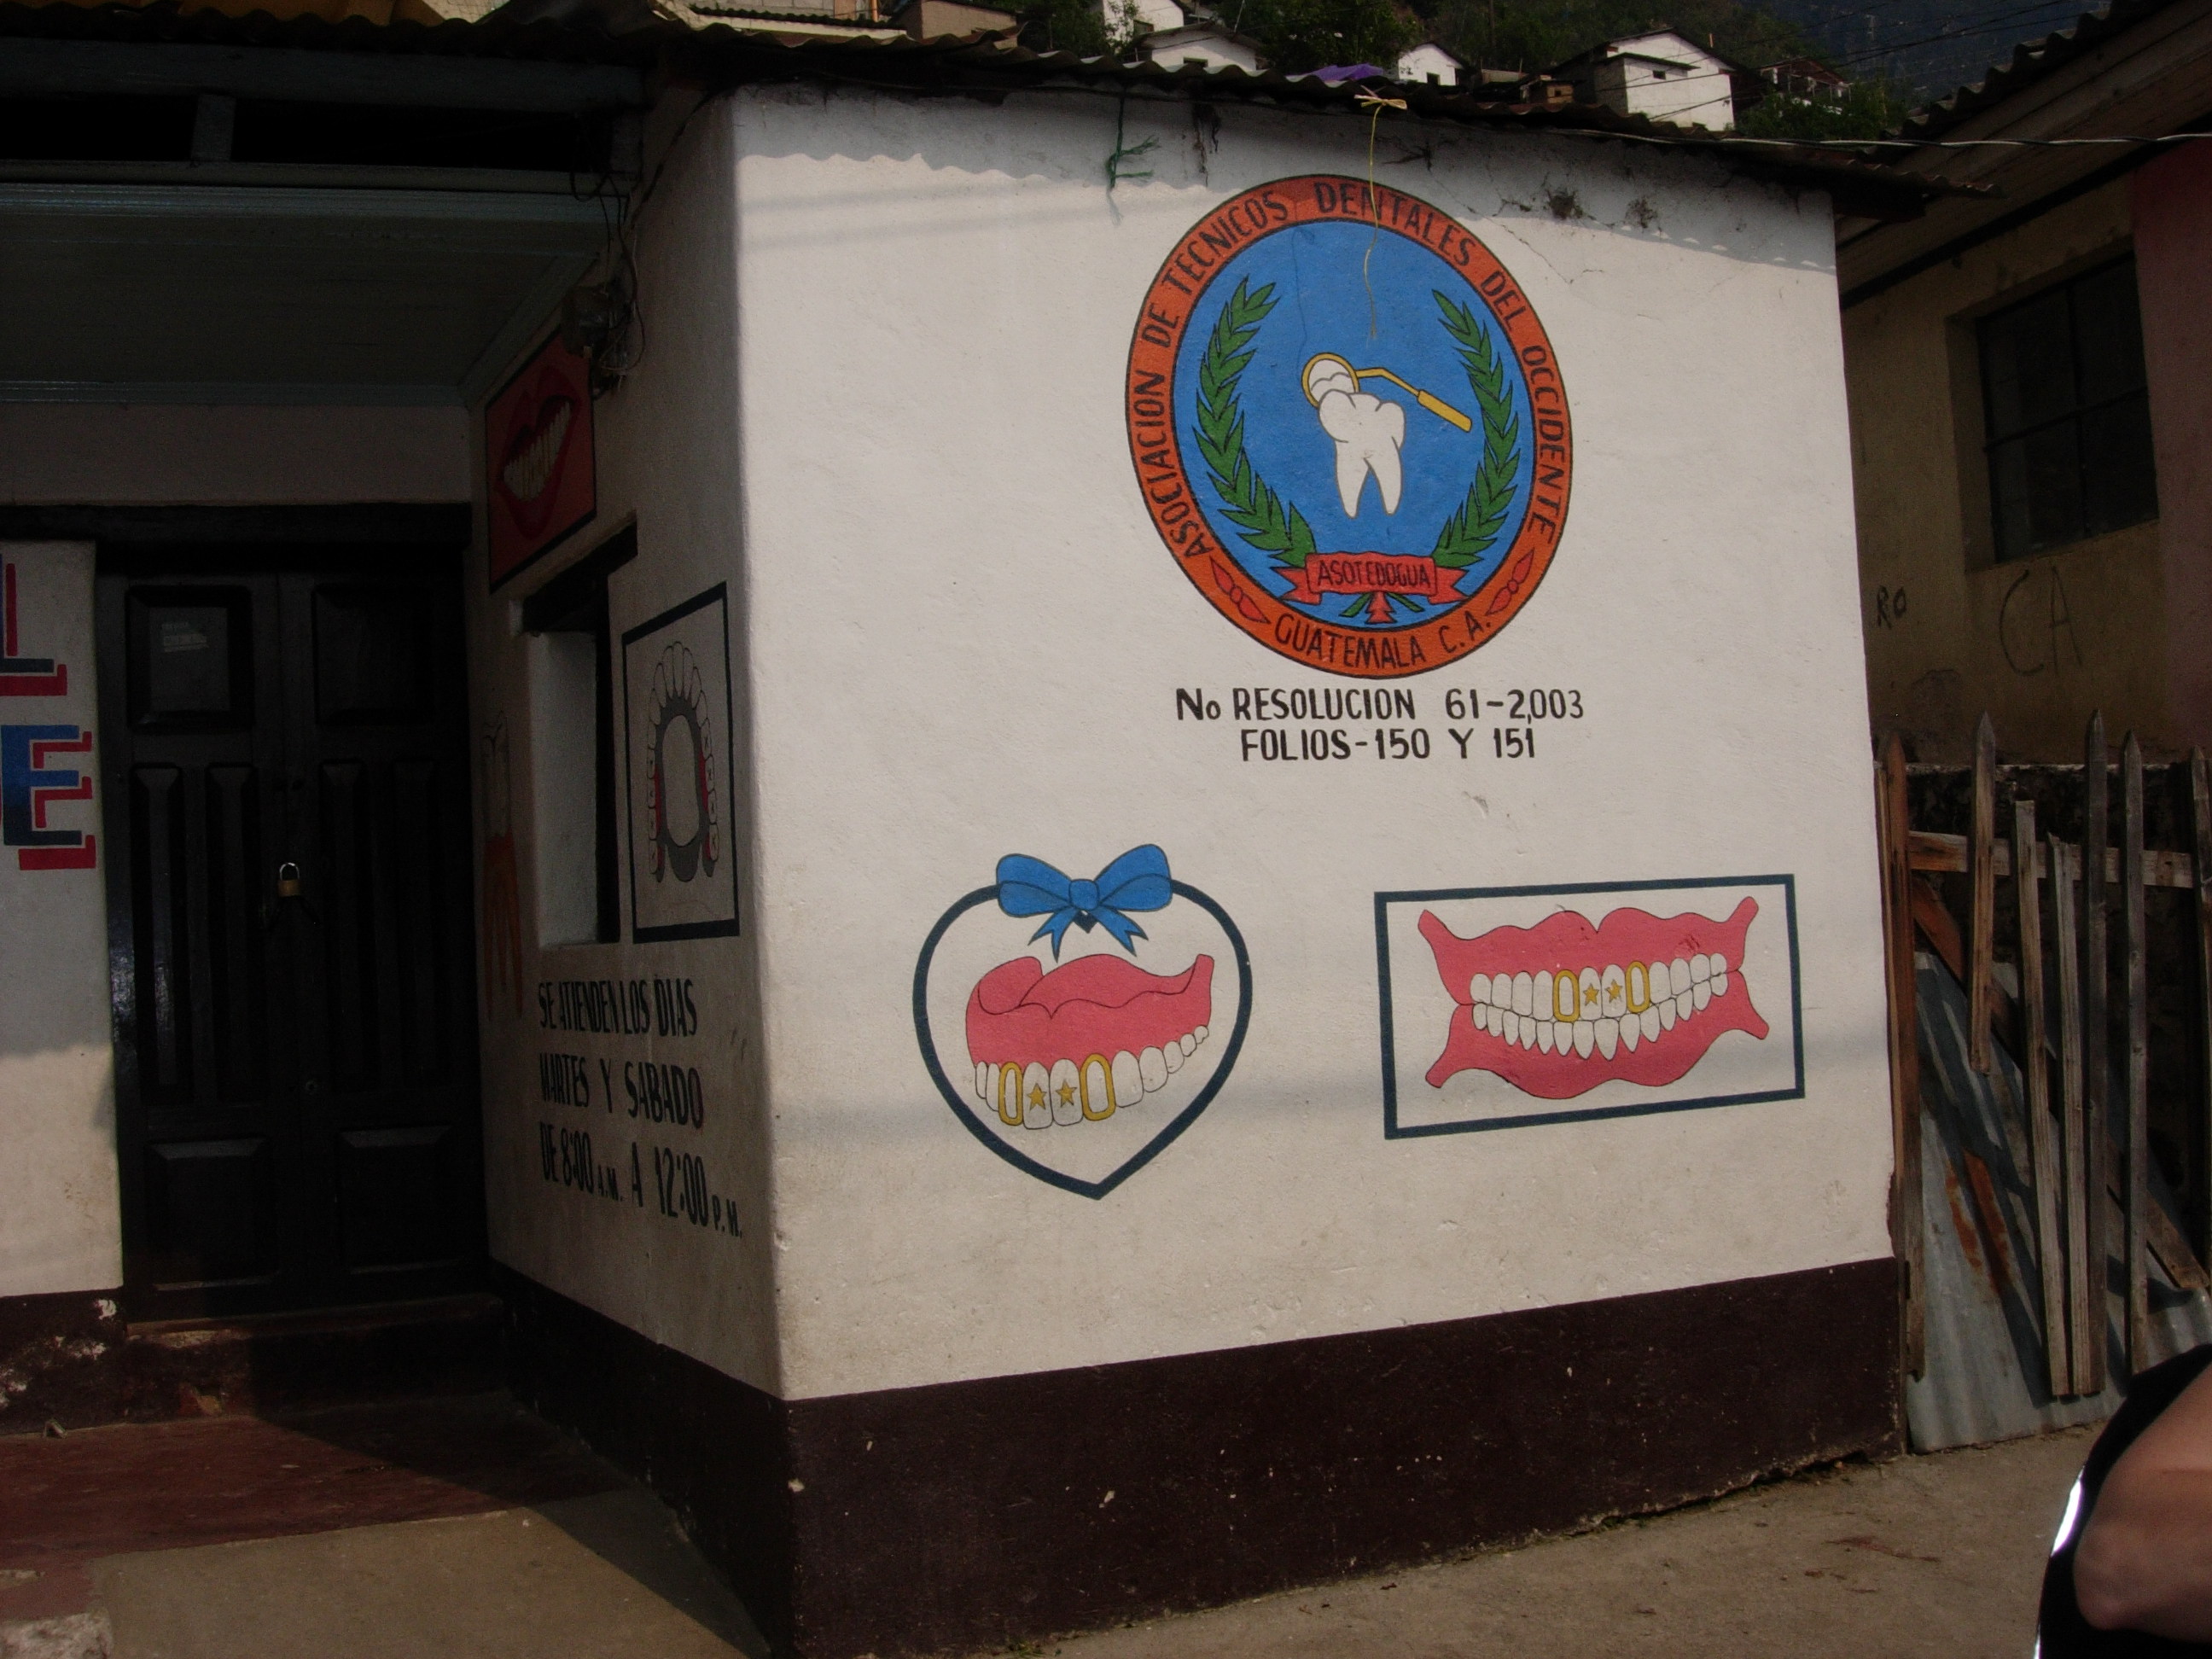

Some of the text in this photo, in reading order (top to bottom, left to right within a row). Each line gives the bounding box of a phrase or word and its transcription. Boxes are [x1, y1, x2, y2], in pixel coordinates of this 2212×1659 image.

[1133, 181, 1569, 557] ASOCIACION DE TECNICOS DENTALES DEL OCCIDENTE
[1317, 559, 1431, 590] ASOTEDOGUA
[1273, 614, 1425, 669] GUATEMALA
[1176, 689, 1584, 725] No RESOLUCION 61-2,003
[1241, 728, 1535, 761] FOLIOS-150 Y 151
[538, 978, 698, 1038] SE ATIENDEN LOS DIAS
[539, 1052, 705, 1129] MARTES Y SABADO
[539, 1121, 559, 1183] DE
[632, 1142, 643, 1208] A
[655, 1146, 709, 1227] 12:00
